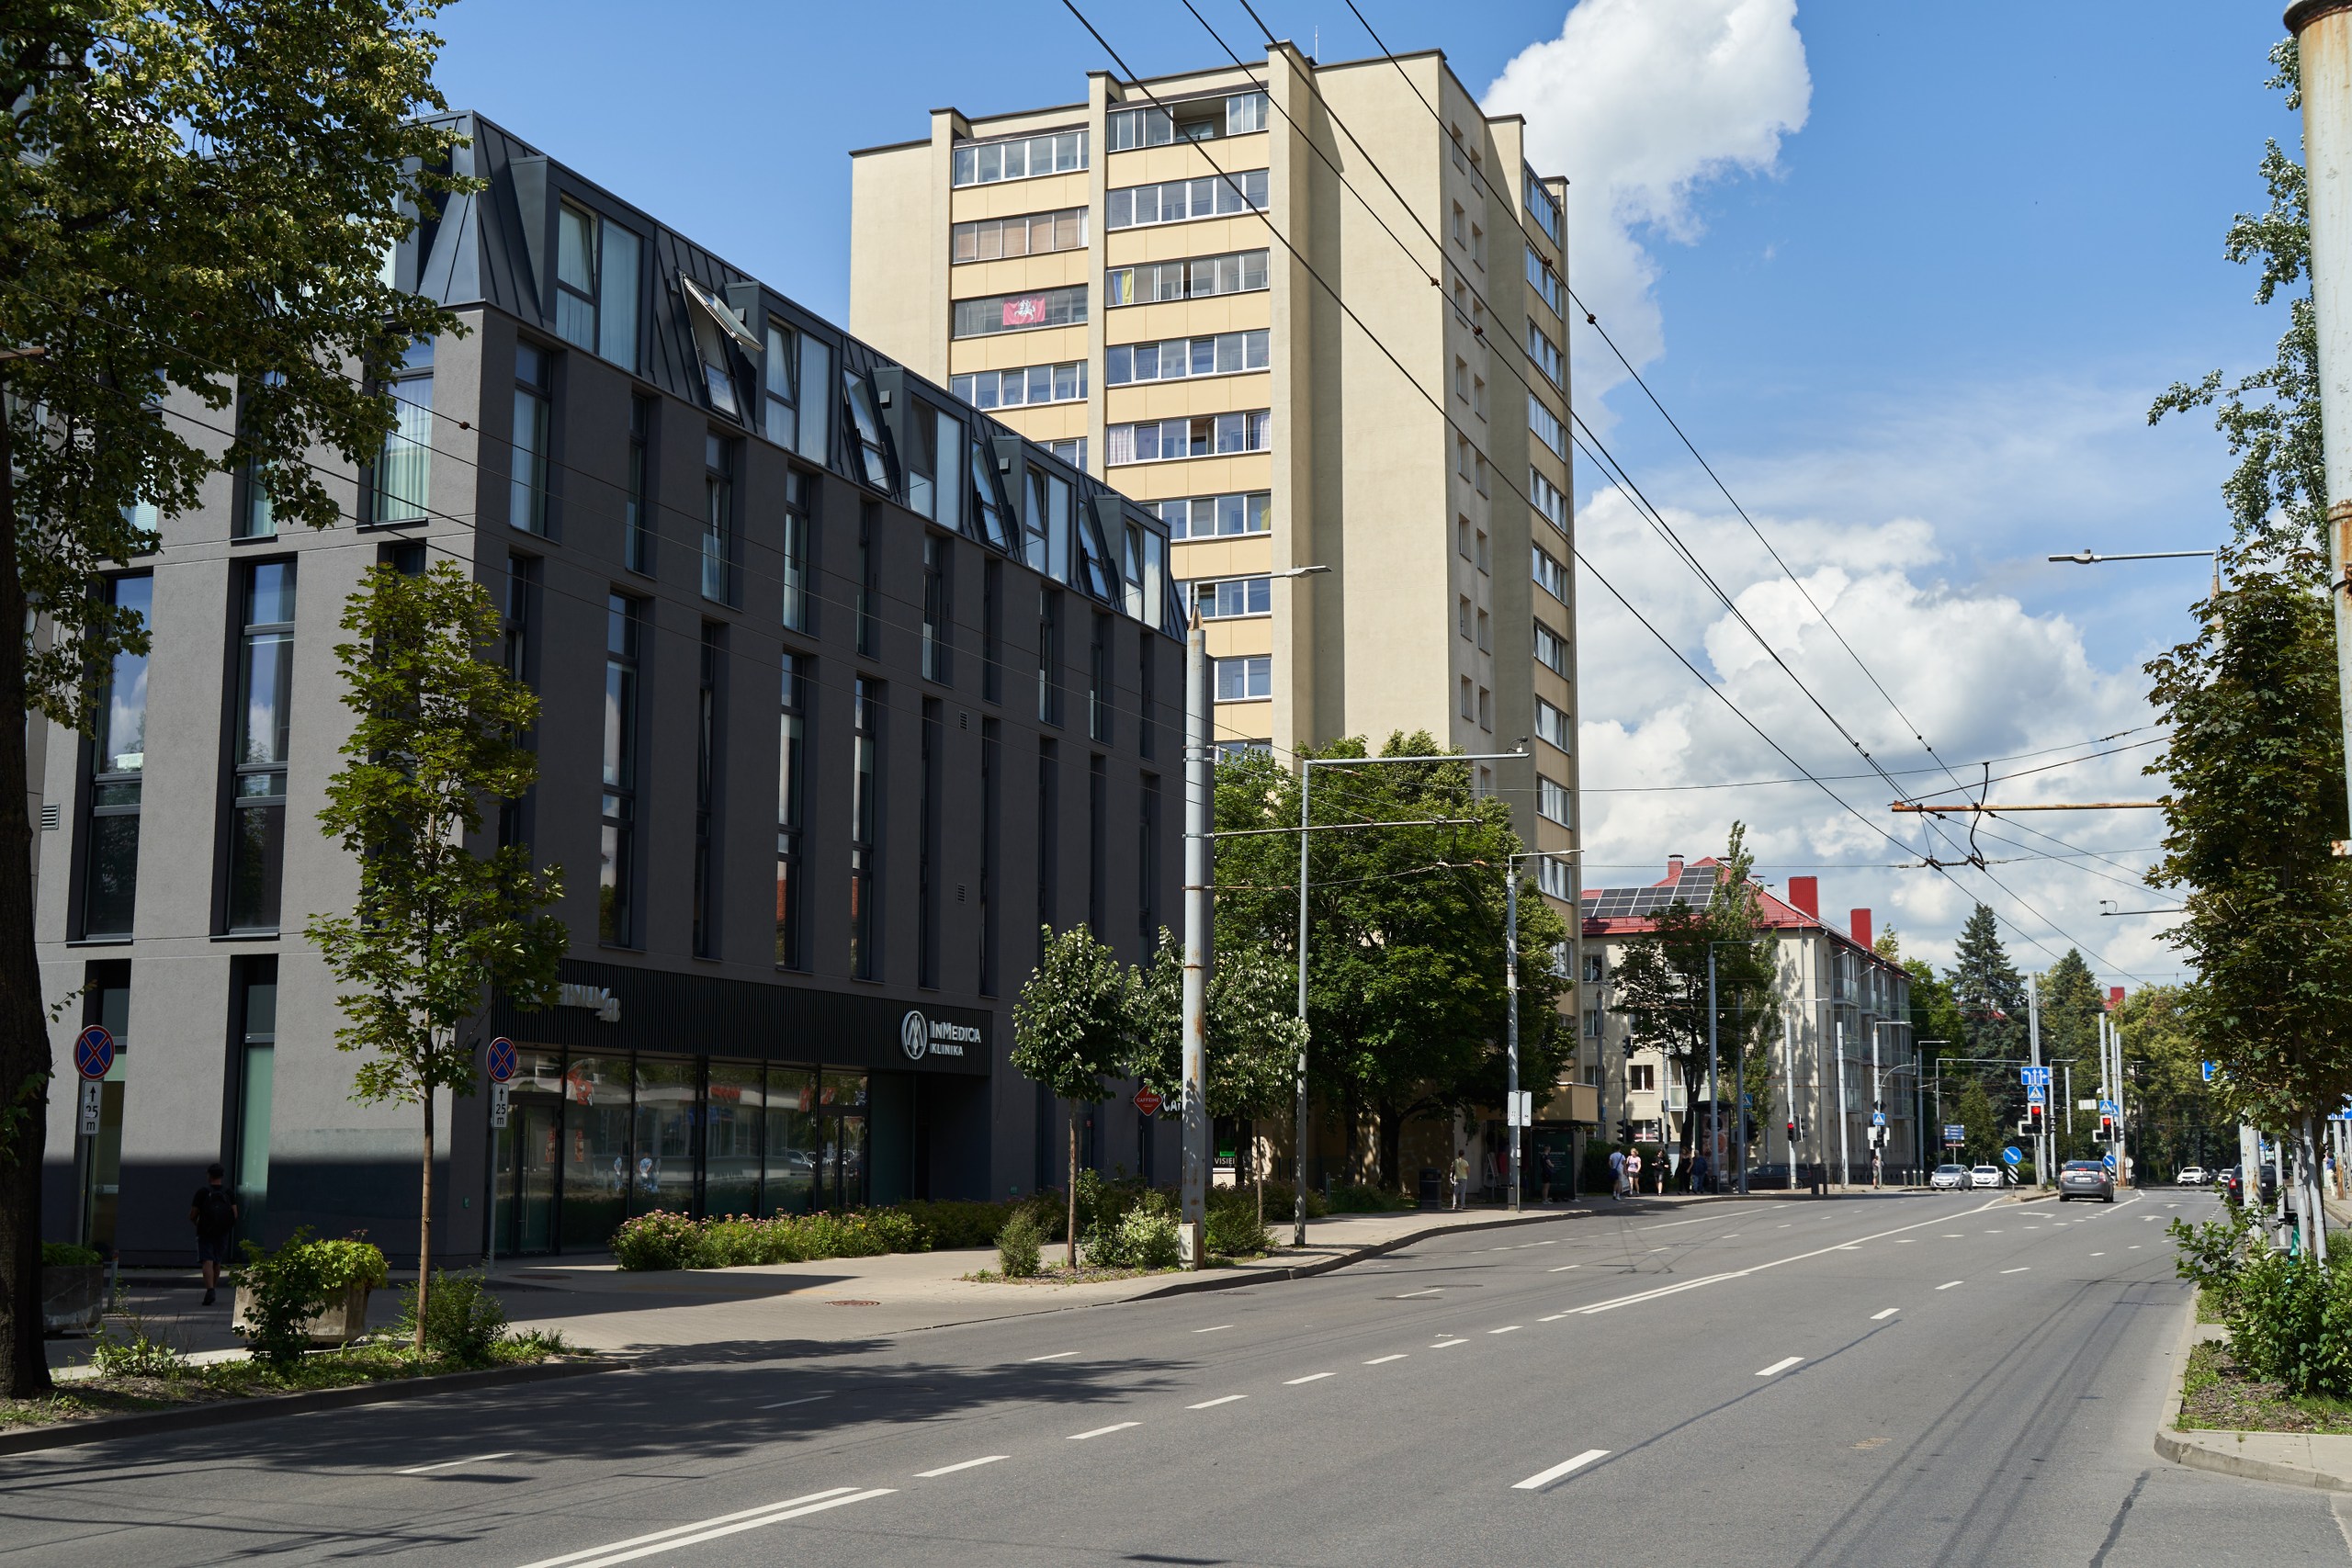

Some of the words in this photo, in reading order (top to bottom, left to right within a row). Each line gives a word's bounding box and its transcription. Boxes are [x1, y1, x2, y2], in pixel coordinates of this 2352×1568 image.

[929, 1043, 964, 1056] KLINIKA
[495, 1103, 506, 1114] 25
[85, 1121, 96, 1131] m
[496, 1117, 504, 1125] m
